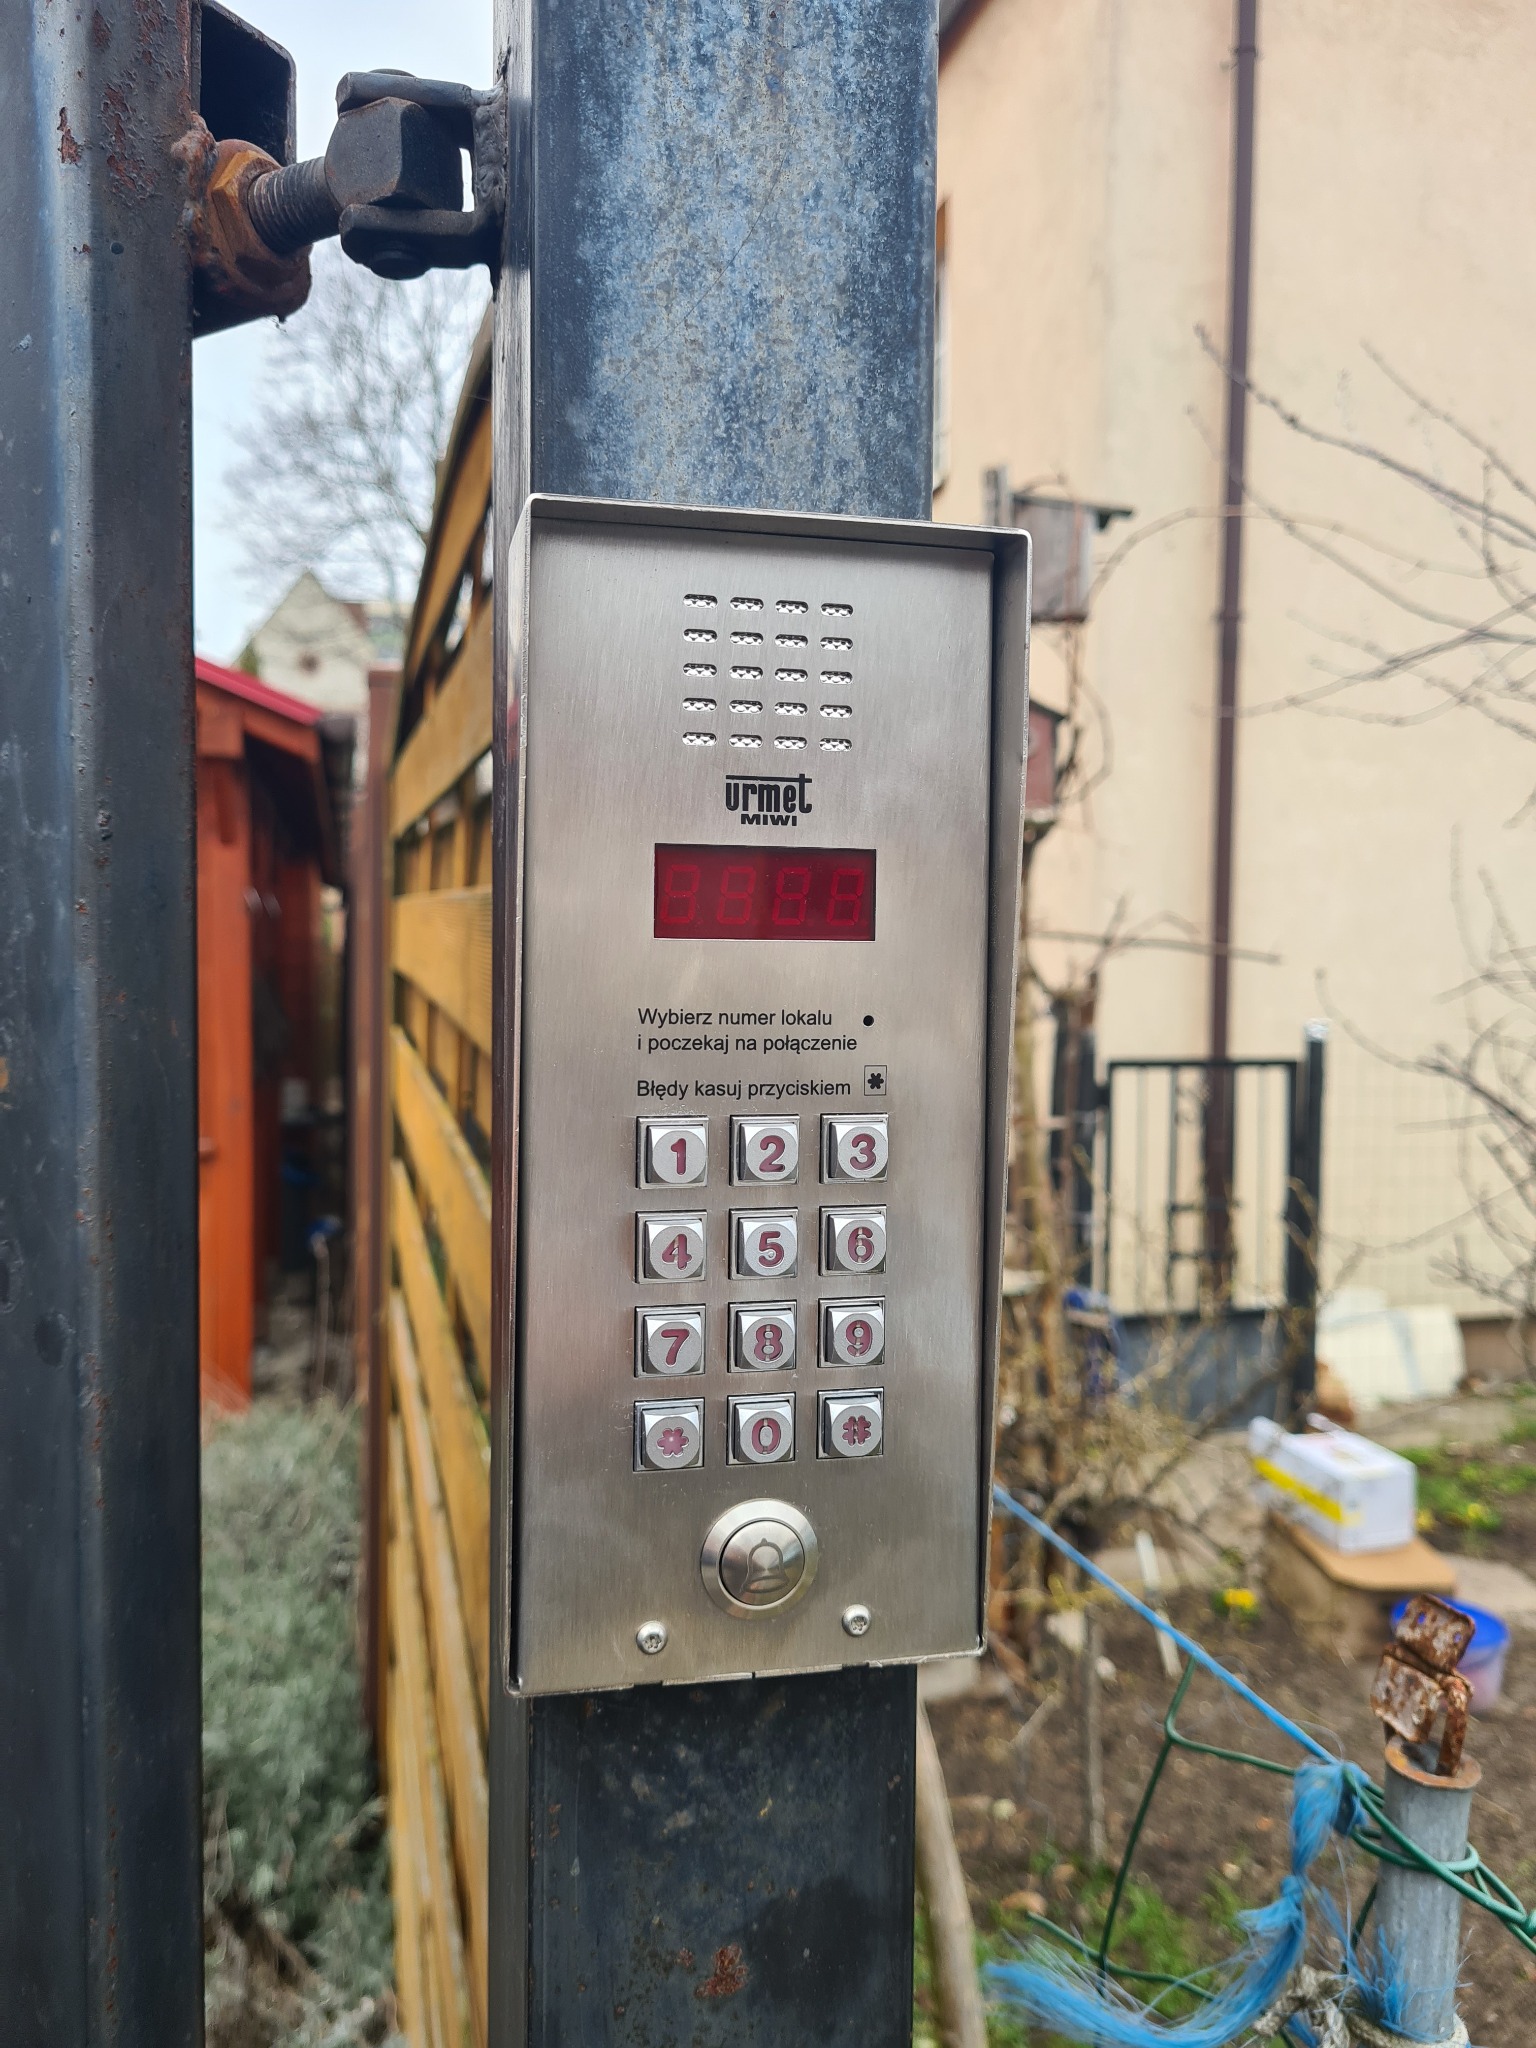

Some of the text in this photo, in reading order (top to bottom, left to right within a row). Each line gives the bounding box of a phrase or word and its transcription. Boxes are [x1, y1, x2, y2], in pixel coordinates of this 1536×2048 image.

[725, 773, 813, 814] urmet
[740, 813, 798, 826] MIWI
[638, 1008, 832, 1029] Wybierz numer lokalu
[637, 1034, 858, 1055] i poczekaj na połączenie
[637, 1080, 689, 1101] Błędy
[694, 1080, 742, 1100] kasuj
[748, 1080, 851, 1101] przyciskiem
[670, 1133, 877, 1175] 1 2 3
[661, 1226, 875, 1271] 4 5 6
[660, 1319, 873, 1366] 7 8 9
[751, 1417, 782, 1455] 0
